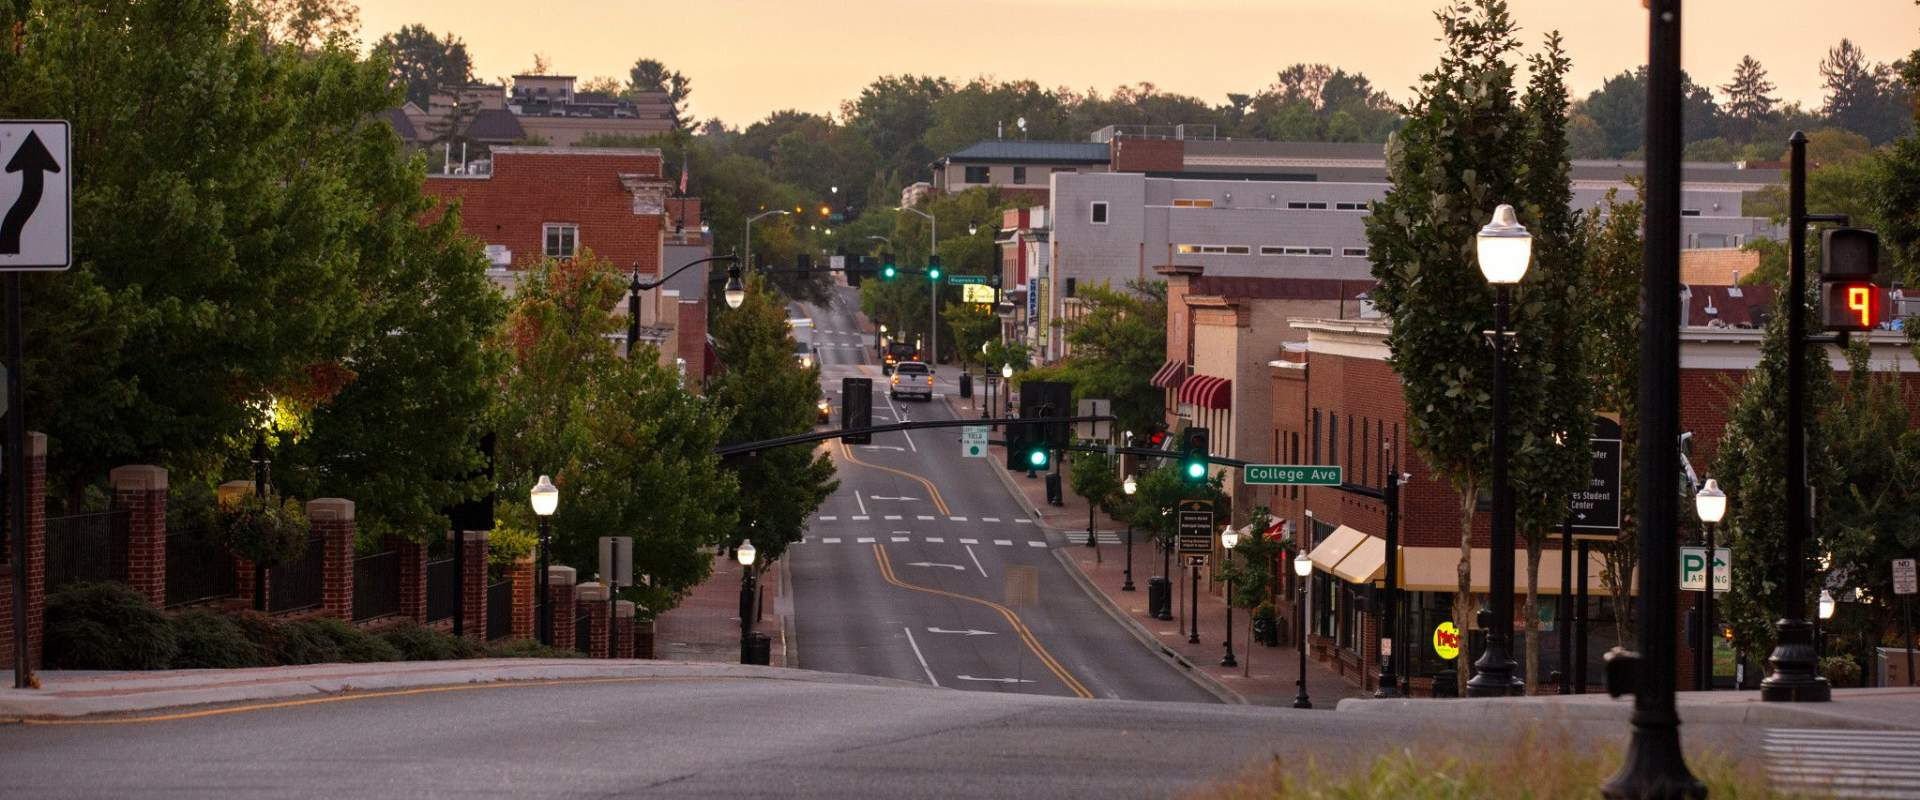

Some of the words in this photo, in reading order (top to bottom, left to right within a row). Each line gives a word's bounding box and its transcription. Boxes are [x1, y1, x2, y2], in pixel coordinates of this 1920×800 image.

[1849, 288, 1869, 326] 9
[1250, 468, 1304, 482] College
[1311, 469, 1336, 480] Ave
[1583, 491, 1610, 501] Student
[1571, 500, 1594, 509] Center
[1684, 554, 1727, 583] PARNG
